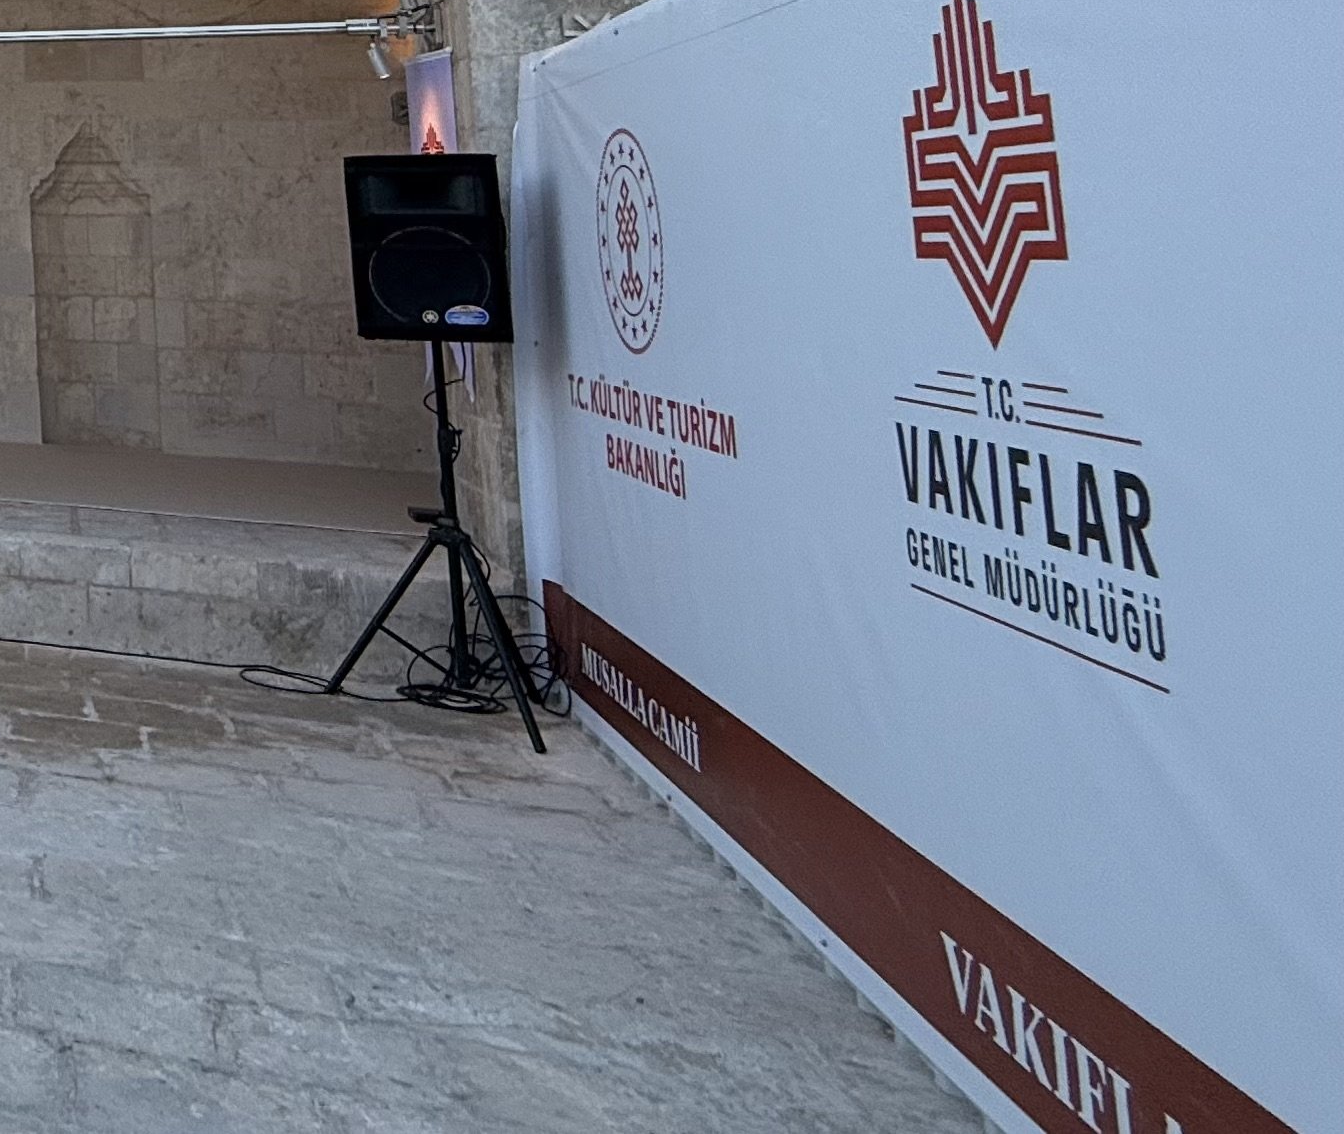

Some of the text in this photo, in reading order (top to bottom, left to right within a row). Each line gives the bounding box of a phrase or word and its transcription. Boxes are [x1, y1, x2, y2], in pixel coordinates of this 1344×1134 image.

[568, 373, 738, 459] T.C. KÜLTÜR VE TURİZM
[981, 376, 1021, 423] T.C.
[606, 433, 687, 500] BAKANLIĞI
[895, 421, 1160, 579] VAKIFLAR
[906, 527, 1166, 662] GENEL MÜDÜRLÜĞÜ
[581, 642, 701, 773] MUSALLA CAMİİ
[940, 930, 1185, 1134] VAKIFL
